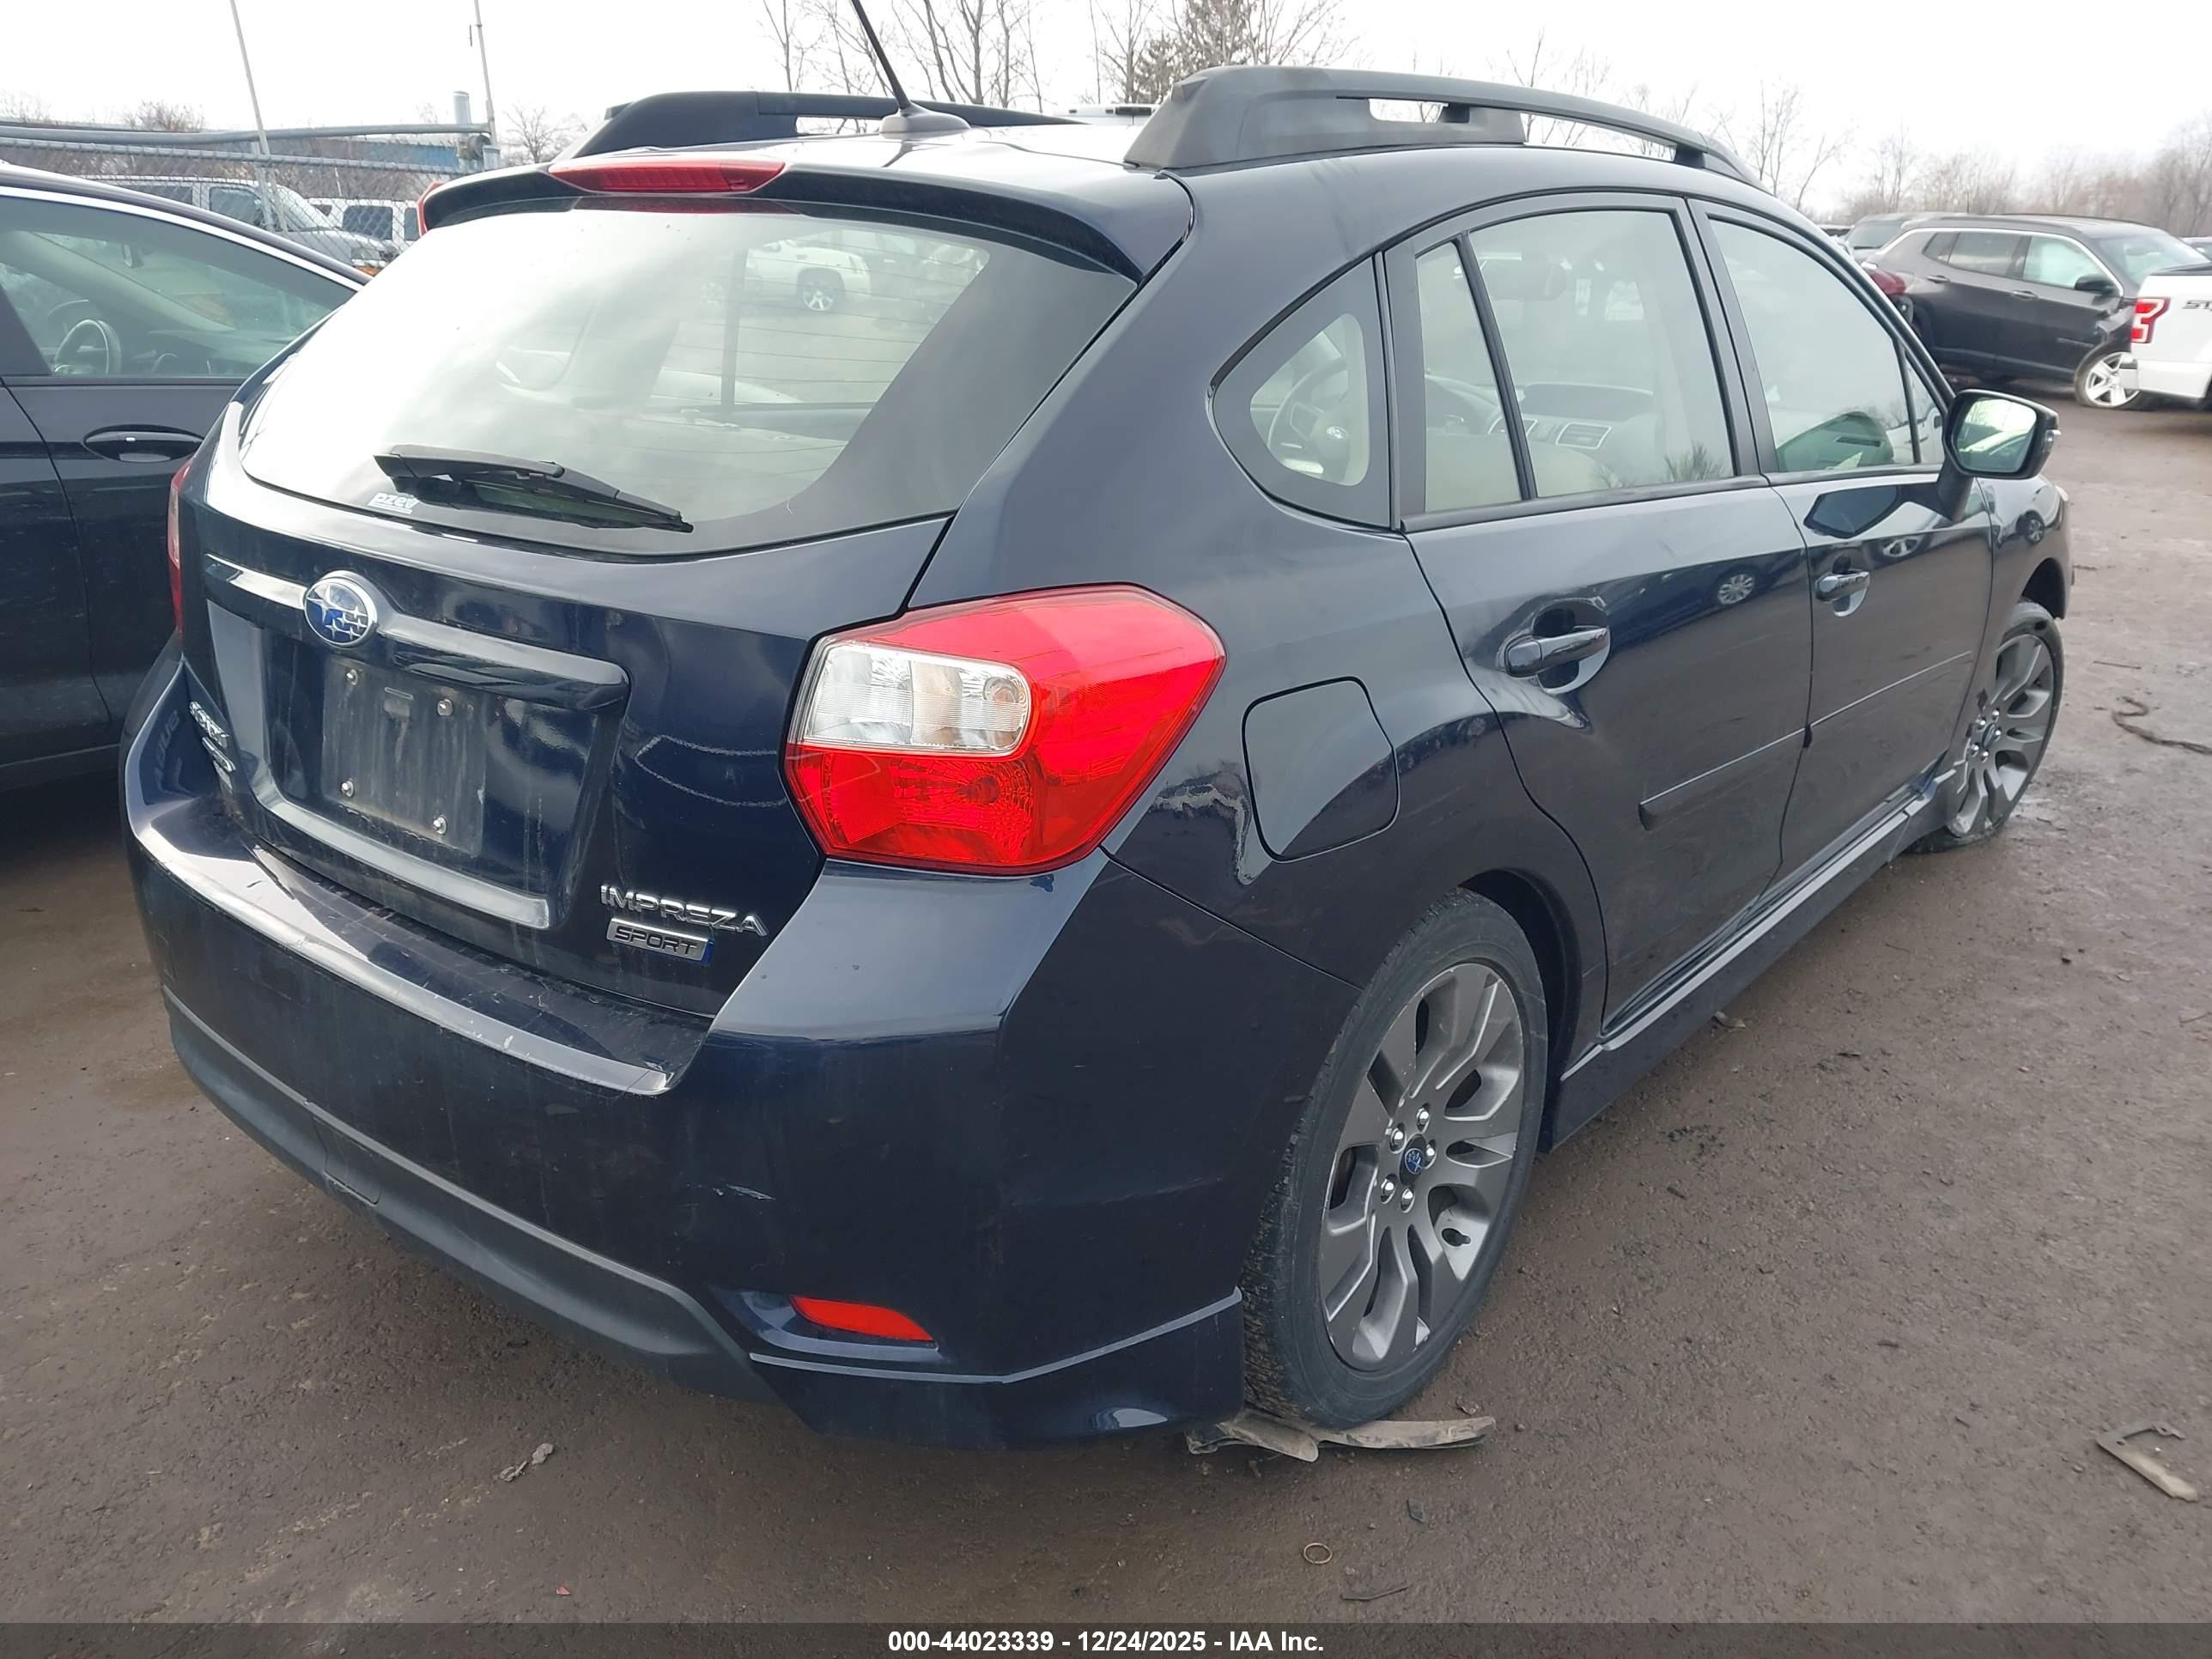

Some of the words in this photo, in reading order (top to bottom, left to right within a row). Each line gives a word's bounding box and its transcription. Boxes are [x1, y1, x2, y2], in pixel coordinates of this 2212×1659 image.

[2182, 300, 2212, 311] ST
[600, 884, 769, 937] IMPREZA
[614, 925, 698, 955] SPORT
